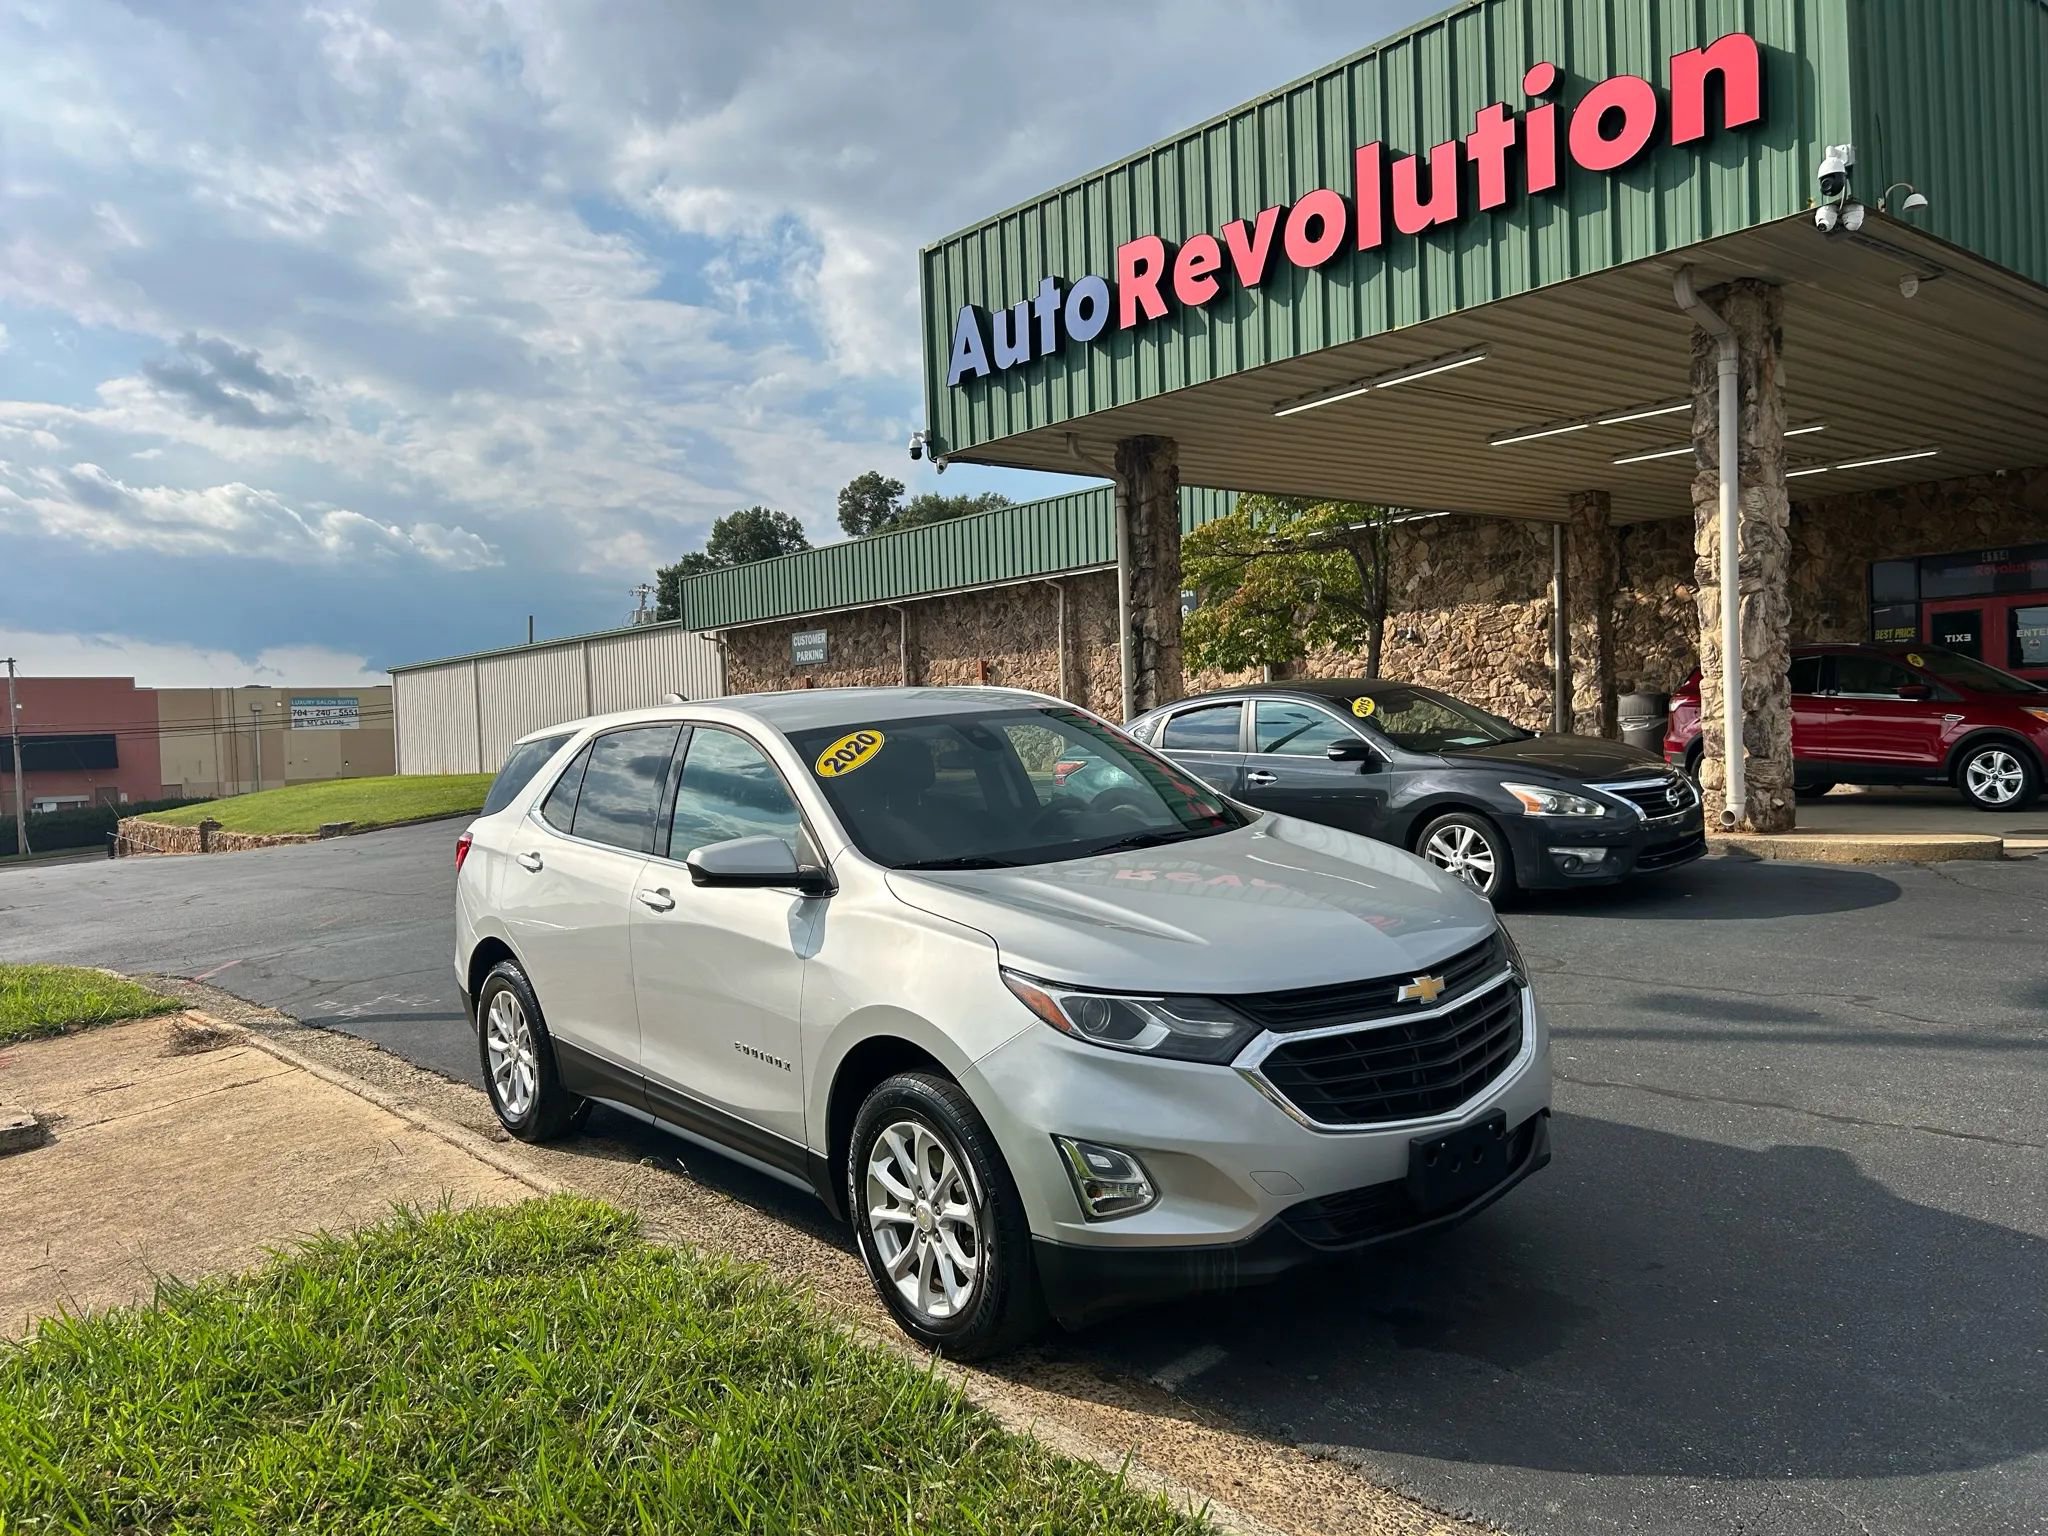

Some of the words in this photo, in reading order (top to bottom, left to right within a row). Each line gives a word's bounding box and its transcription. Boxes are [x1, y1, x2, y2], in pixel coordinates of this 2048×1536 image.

[793, 633, 826, 647] CUSTOMER
[1875, 629, 1893, 640] BEST
[1894, 627, 1916, 639] PRICE
[796, 649, 824, 662] PARKING
[823, 733, 877, 773] 2020
